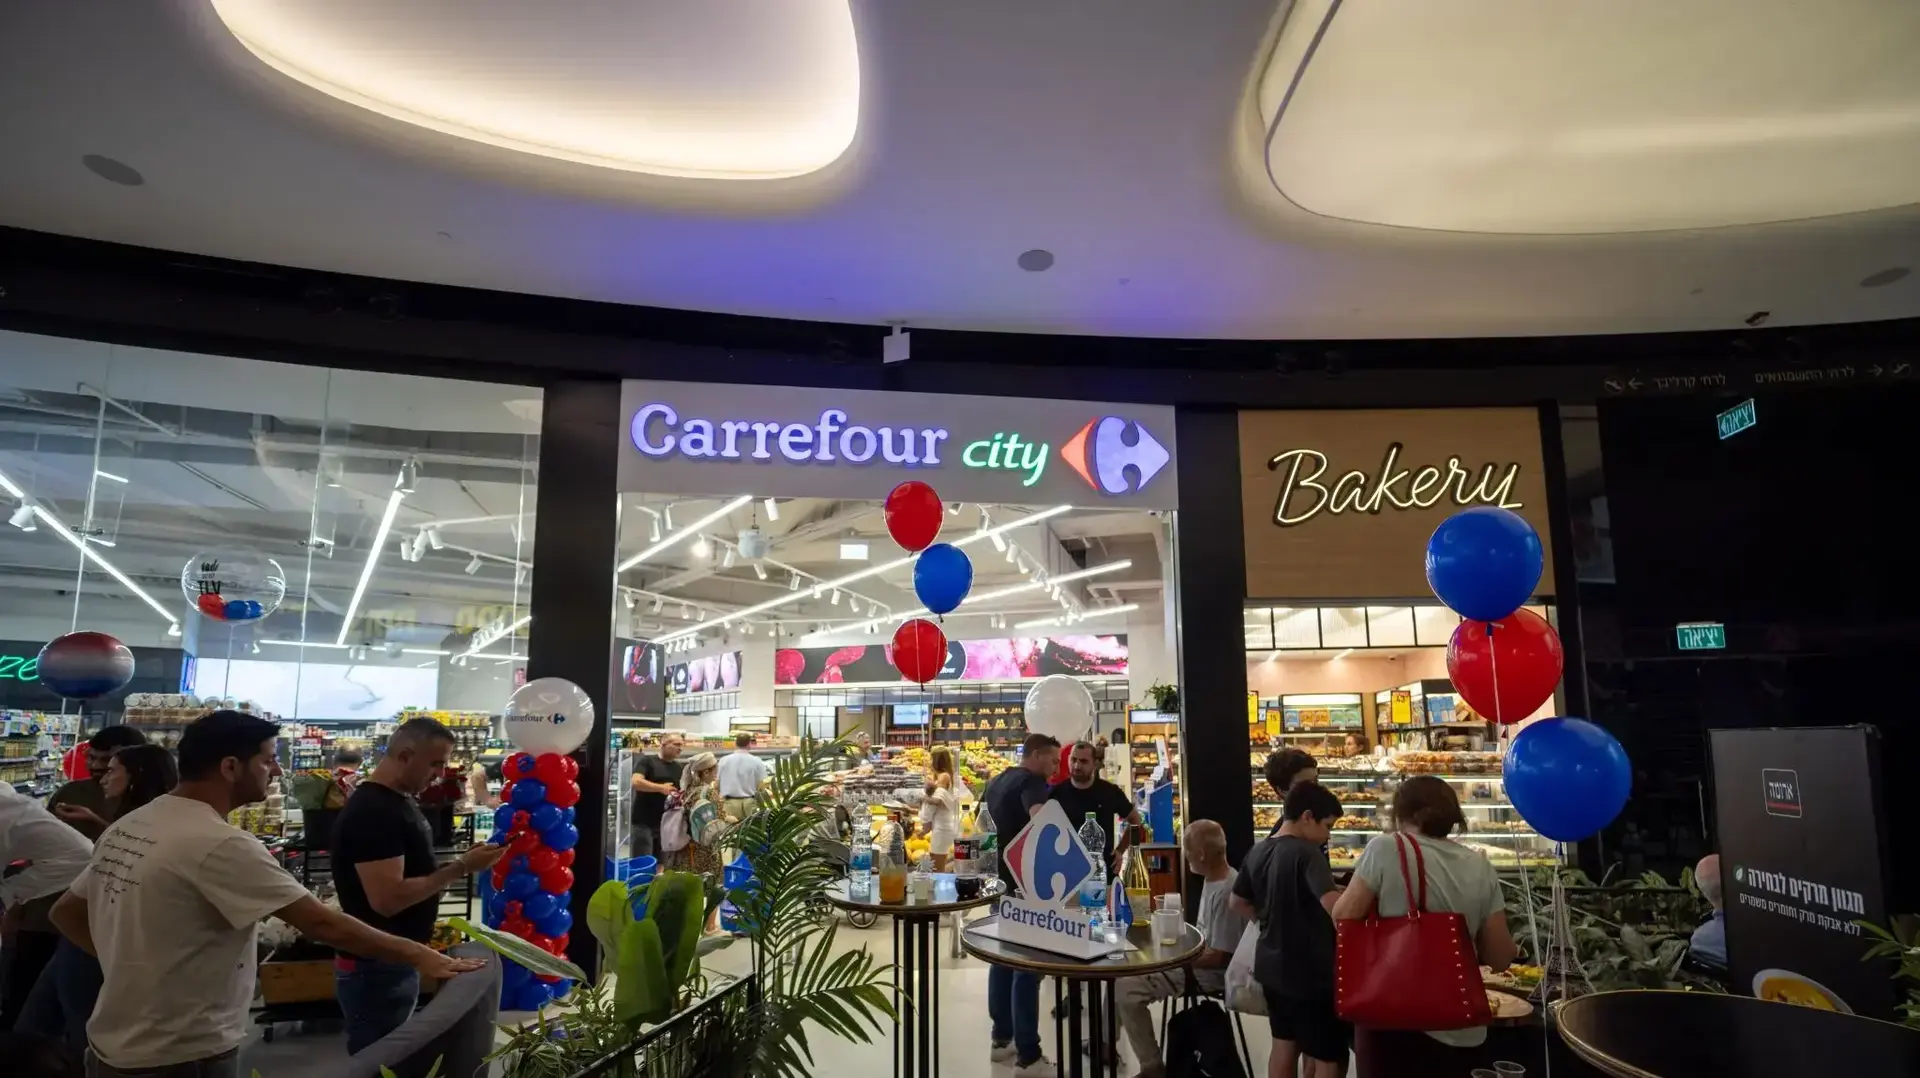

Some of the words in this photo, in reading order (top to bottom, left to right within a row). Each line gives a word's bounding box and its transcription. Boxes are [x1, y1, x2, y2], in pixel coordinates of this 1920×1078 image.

[1725, 402, 1752, 434] יציאה
[629, 402, 949, 465] Carrefour
[961, 431, 1049, 487] city
[1270, 443, 1524, 525] Bakery
[1684, 627, 1718, 648] יציאה
[507, 712, 546, 724] arrefour
[1747, 867, 1786, 895] לבחירה
[1788, 876, 1829, 905] מרקים
[1798, 907, 1816, 923] מרק
[1830, 886, 1865, 915] מגוון
[1000, 899, 1086, 938] Carrefour
[1817, 913, 1842, 931] אבקת
